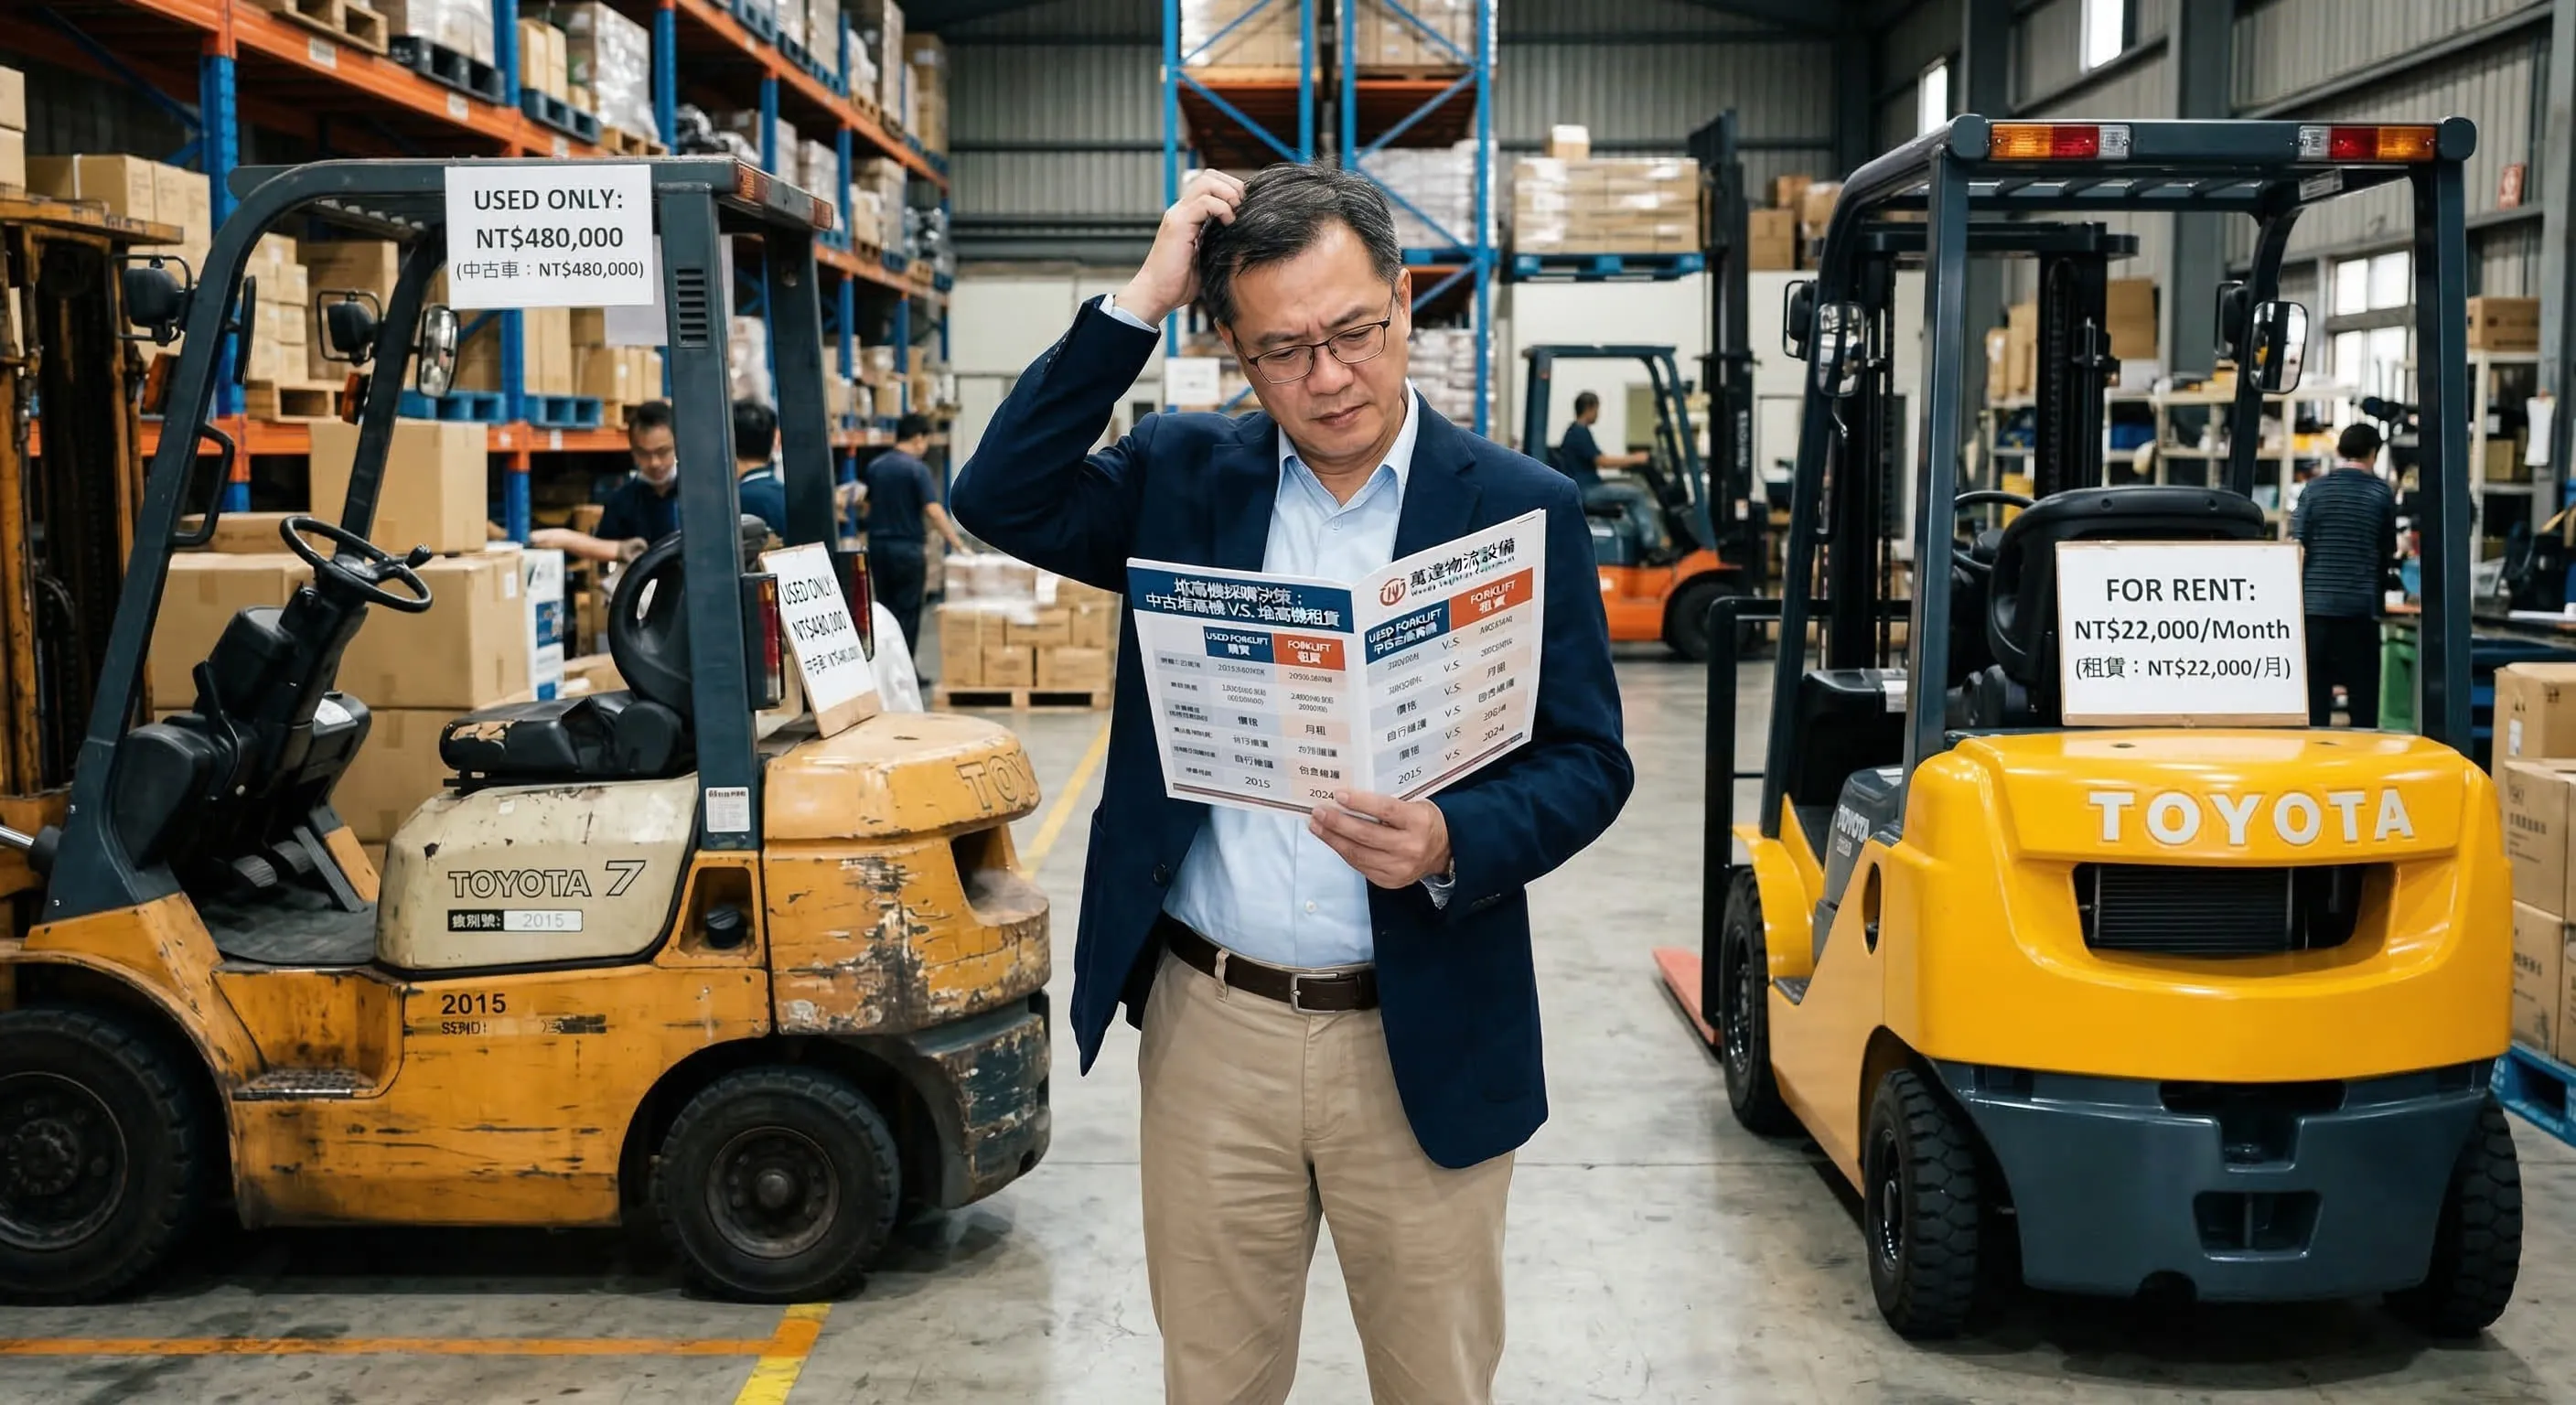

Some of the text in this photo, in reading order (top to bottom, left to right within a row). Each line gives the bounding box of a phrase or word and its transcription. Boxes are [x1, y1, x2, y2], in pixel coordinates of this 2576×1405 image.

[474, 188, 624, 210] USED ONLY:
[476, 224, 624, 252] NT$480,000
[780, 579, 810, 606] USED
[1470, 579, 1517, 605] FORKLIFT
[2106, 577, 2256, 602] FOR RENT:
[2074, 617, 2291, 644] NT$22,000/Month
[1245, 776, 1271, 788] 2015
[1398, 767, 1422, 784] 2015
[1309, 788, 1335, 800] 2024
[2088, 788, 2415, 846] TOYOTA
[447, 860, 646, 898] TOYOTA 7
[522, 913, 565, 928] 2015
[441, 992, 507, 1015] 2015
